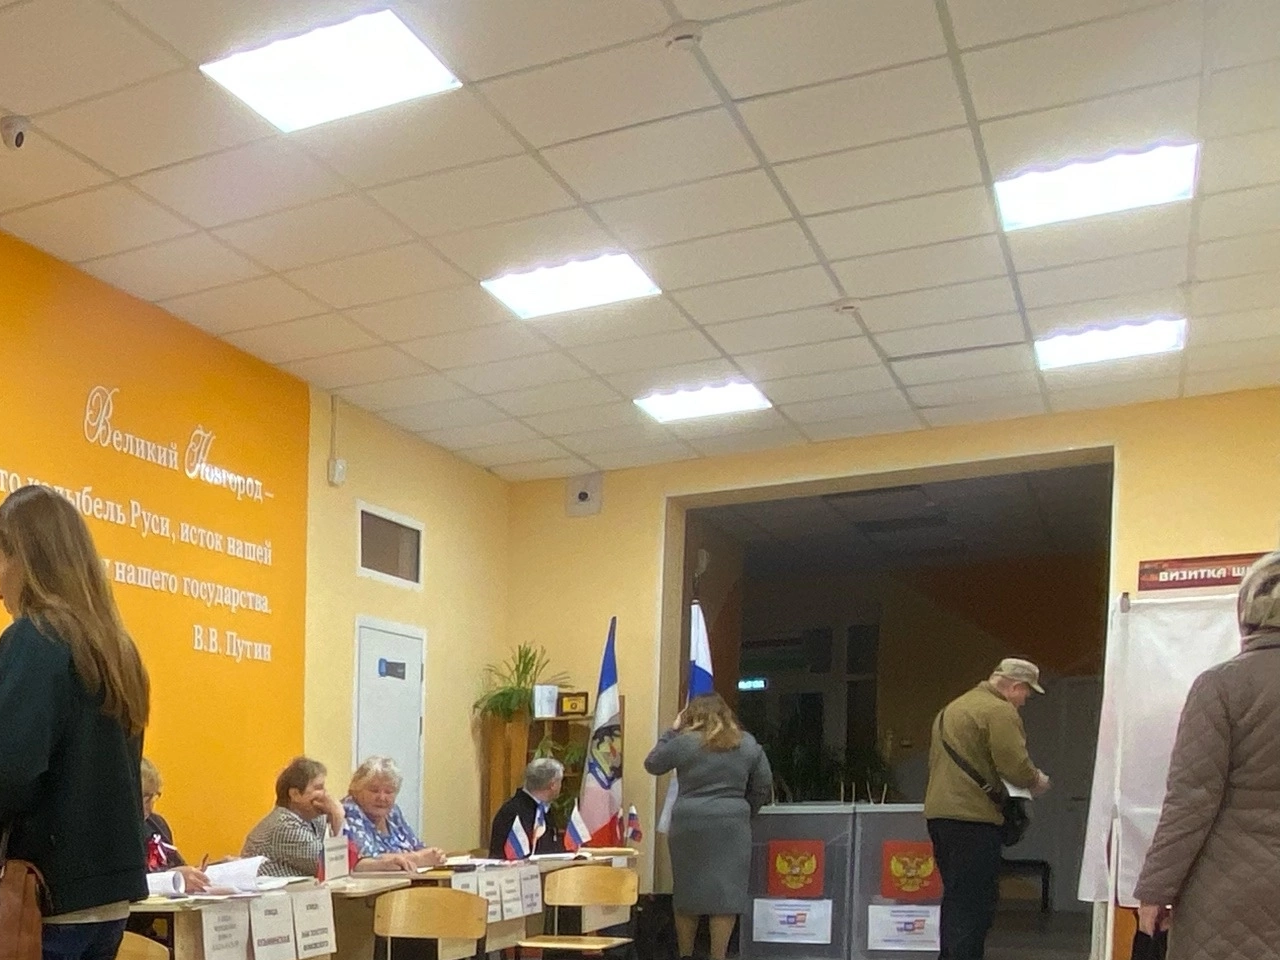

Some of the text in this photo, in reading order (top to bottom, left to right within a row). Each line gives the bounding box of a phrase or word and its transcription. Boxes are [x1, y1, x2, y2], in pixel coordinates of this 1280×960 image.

[84, 385, 180, 471] Великий
[184, 424, 263, 504] Новгород
[130, 499, 176, 544] Руси,
[180, 522, 224, 553] исток
[227, 537, 273, 567] нашей
[114, 561, 178, 595] нашего
[182, 576, 272, 614] государства.
[1158, 567, 1227, 582] ВИЗИТКА
[193, 624, 272, 664] В.В. Путин
